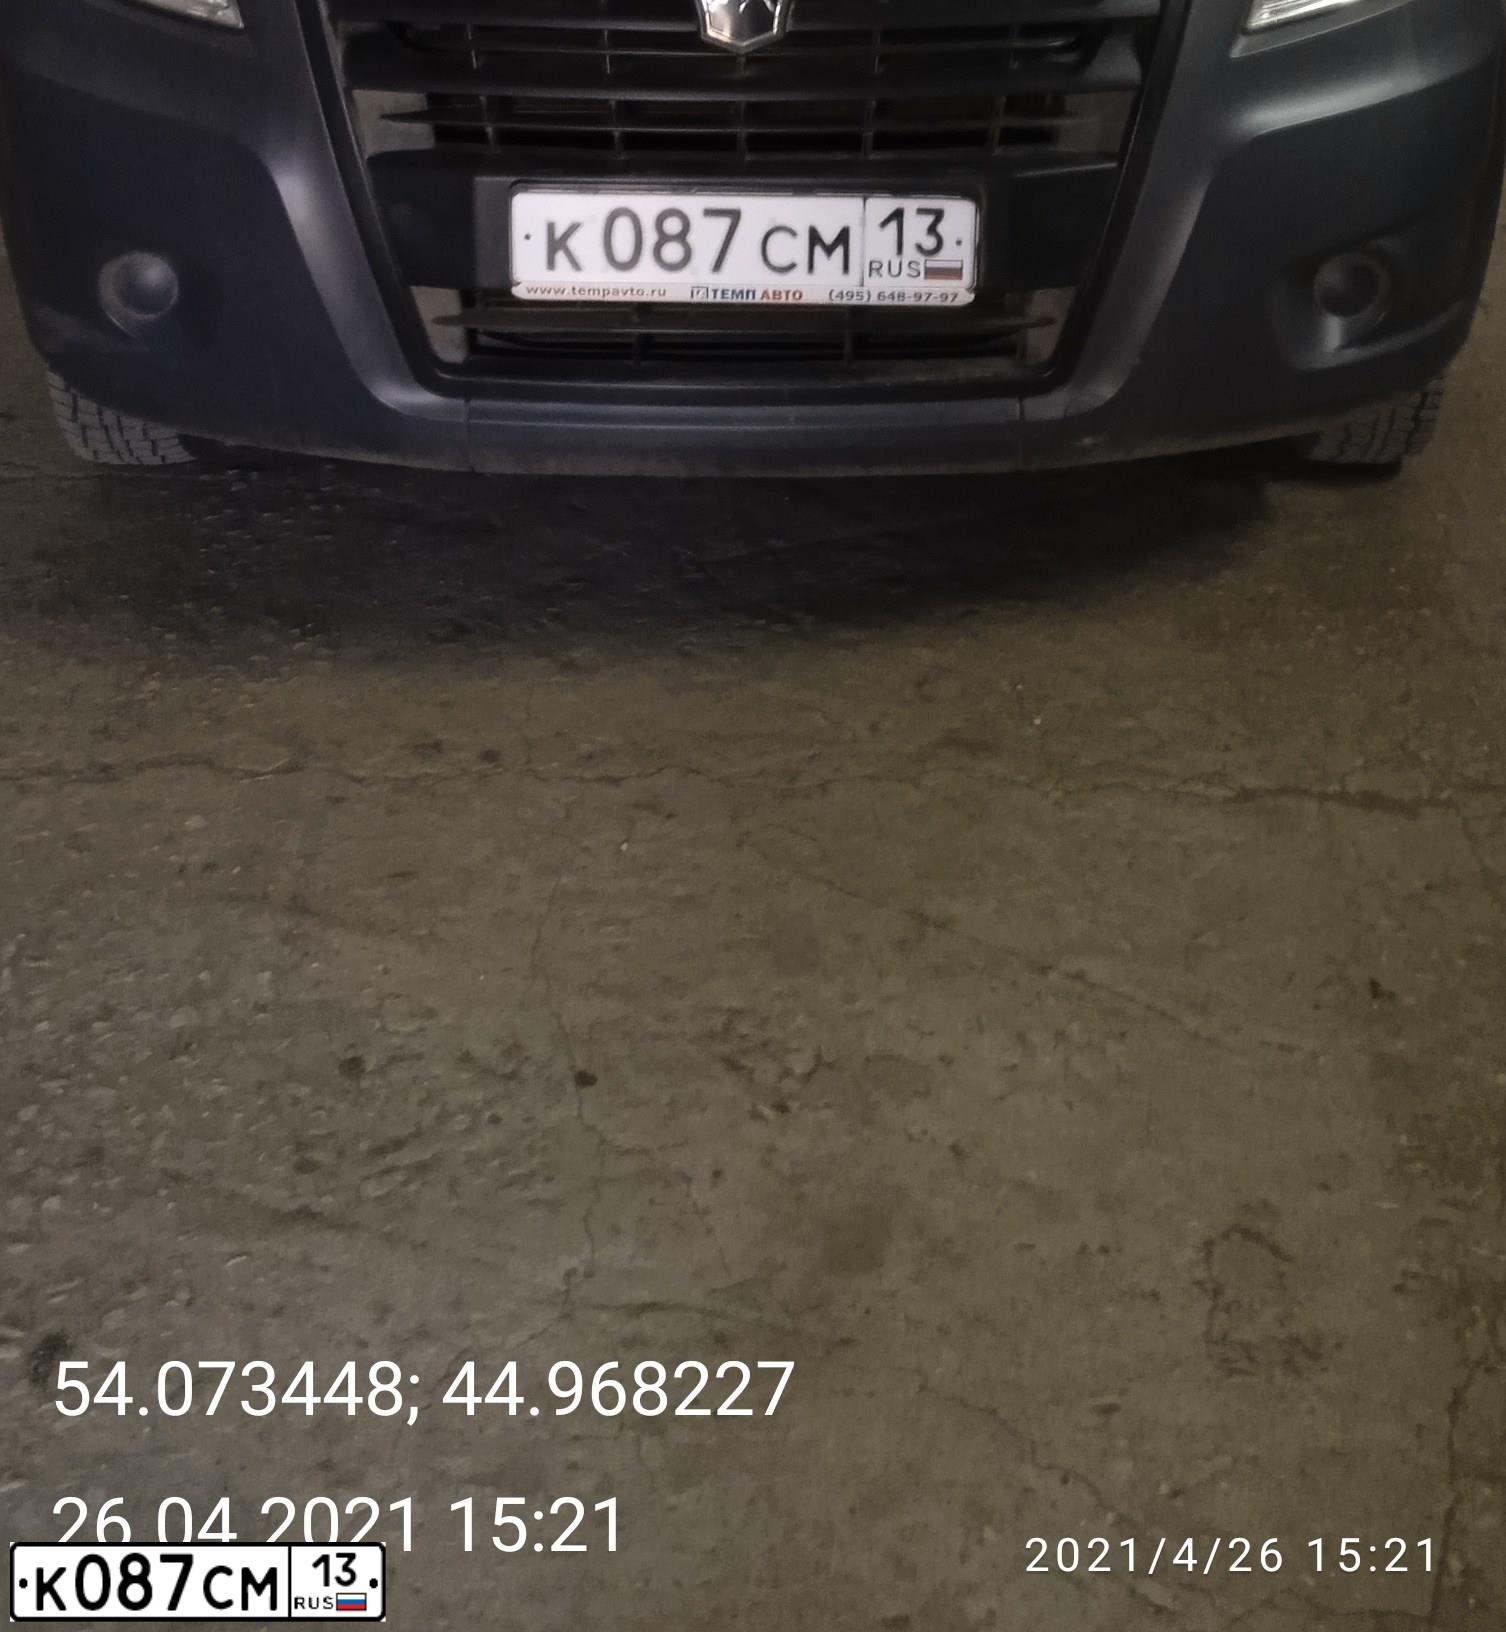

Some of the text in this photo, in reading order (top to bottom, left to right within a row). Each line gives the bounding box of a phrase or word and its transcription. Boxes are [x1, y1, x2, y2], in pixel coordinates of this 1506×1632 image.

[879, 207, 945, 257] 13
[868, 259, 921, 279] RUS
[526, 284, 667, 299] www.tempavto.ru
[711, 288, 803, 302] ТЕМП АВТО
[828, 289, 959, 304] (495) 648-97-97
